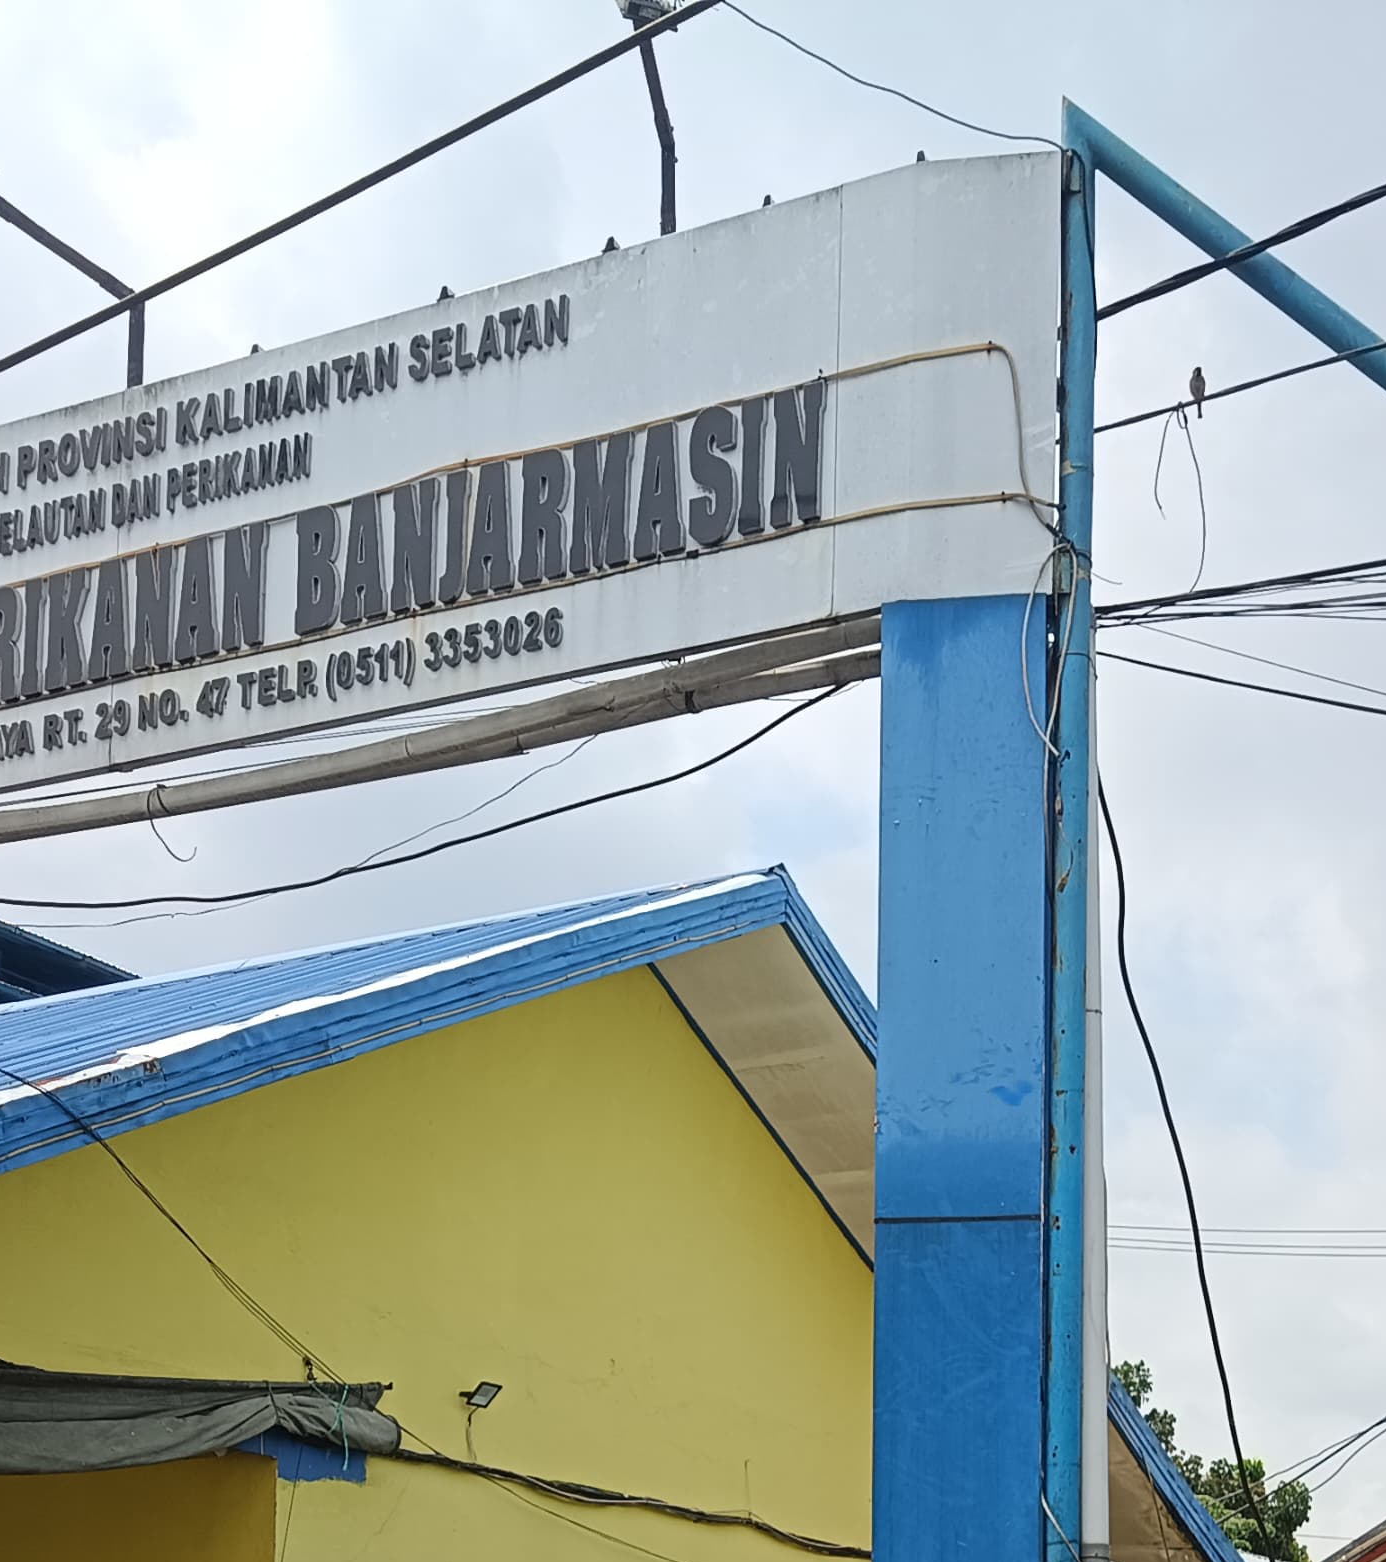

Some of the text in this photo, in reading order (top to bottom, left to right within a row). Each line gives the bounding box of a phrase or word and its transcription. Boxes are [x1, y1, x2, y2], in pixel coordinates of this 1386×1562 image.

[16, 408, 167, 490] PROVINSI
[174, 340, 399, 445] KALIMANTAN
[408, 294, 571, 383] SELATAN
[111, 472, 161, 529] DAN
[166, 432, 312, 515] PERIKANAN
[294, 379, 828, 638] BANJARMASIN
[42, 708, 88, 752] RT.
[95, 702, 131, 741] 29
[137, 690, 190, 731] NO.
[195, 676, 231, 720] 47
[236, 658, 319, 713] TELP.
[326, 637, 416, 702] (0511)
[423, 607, 564, 672] 3353026
